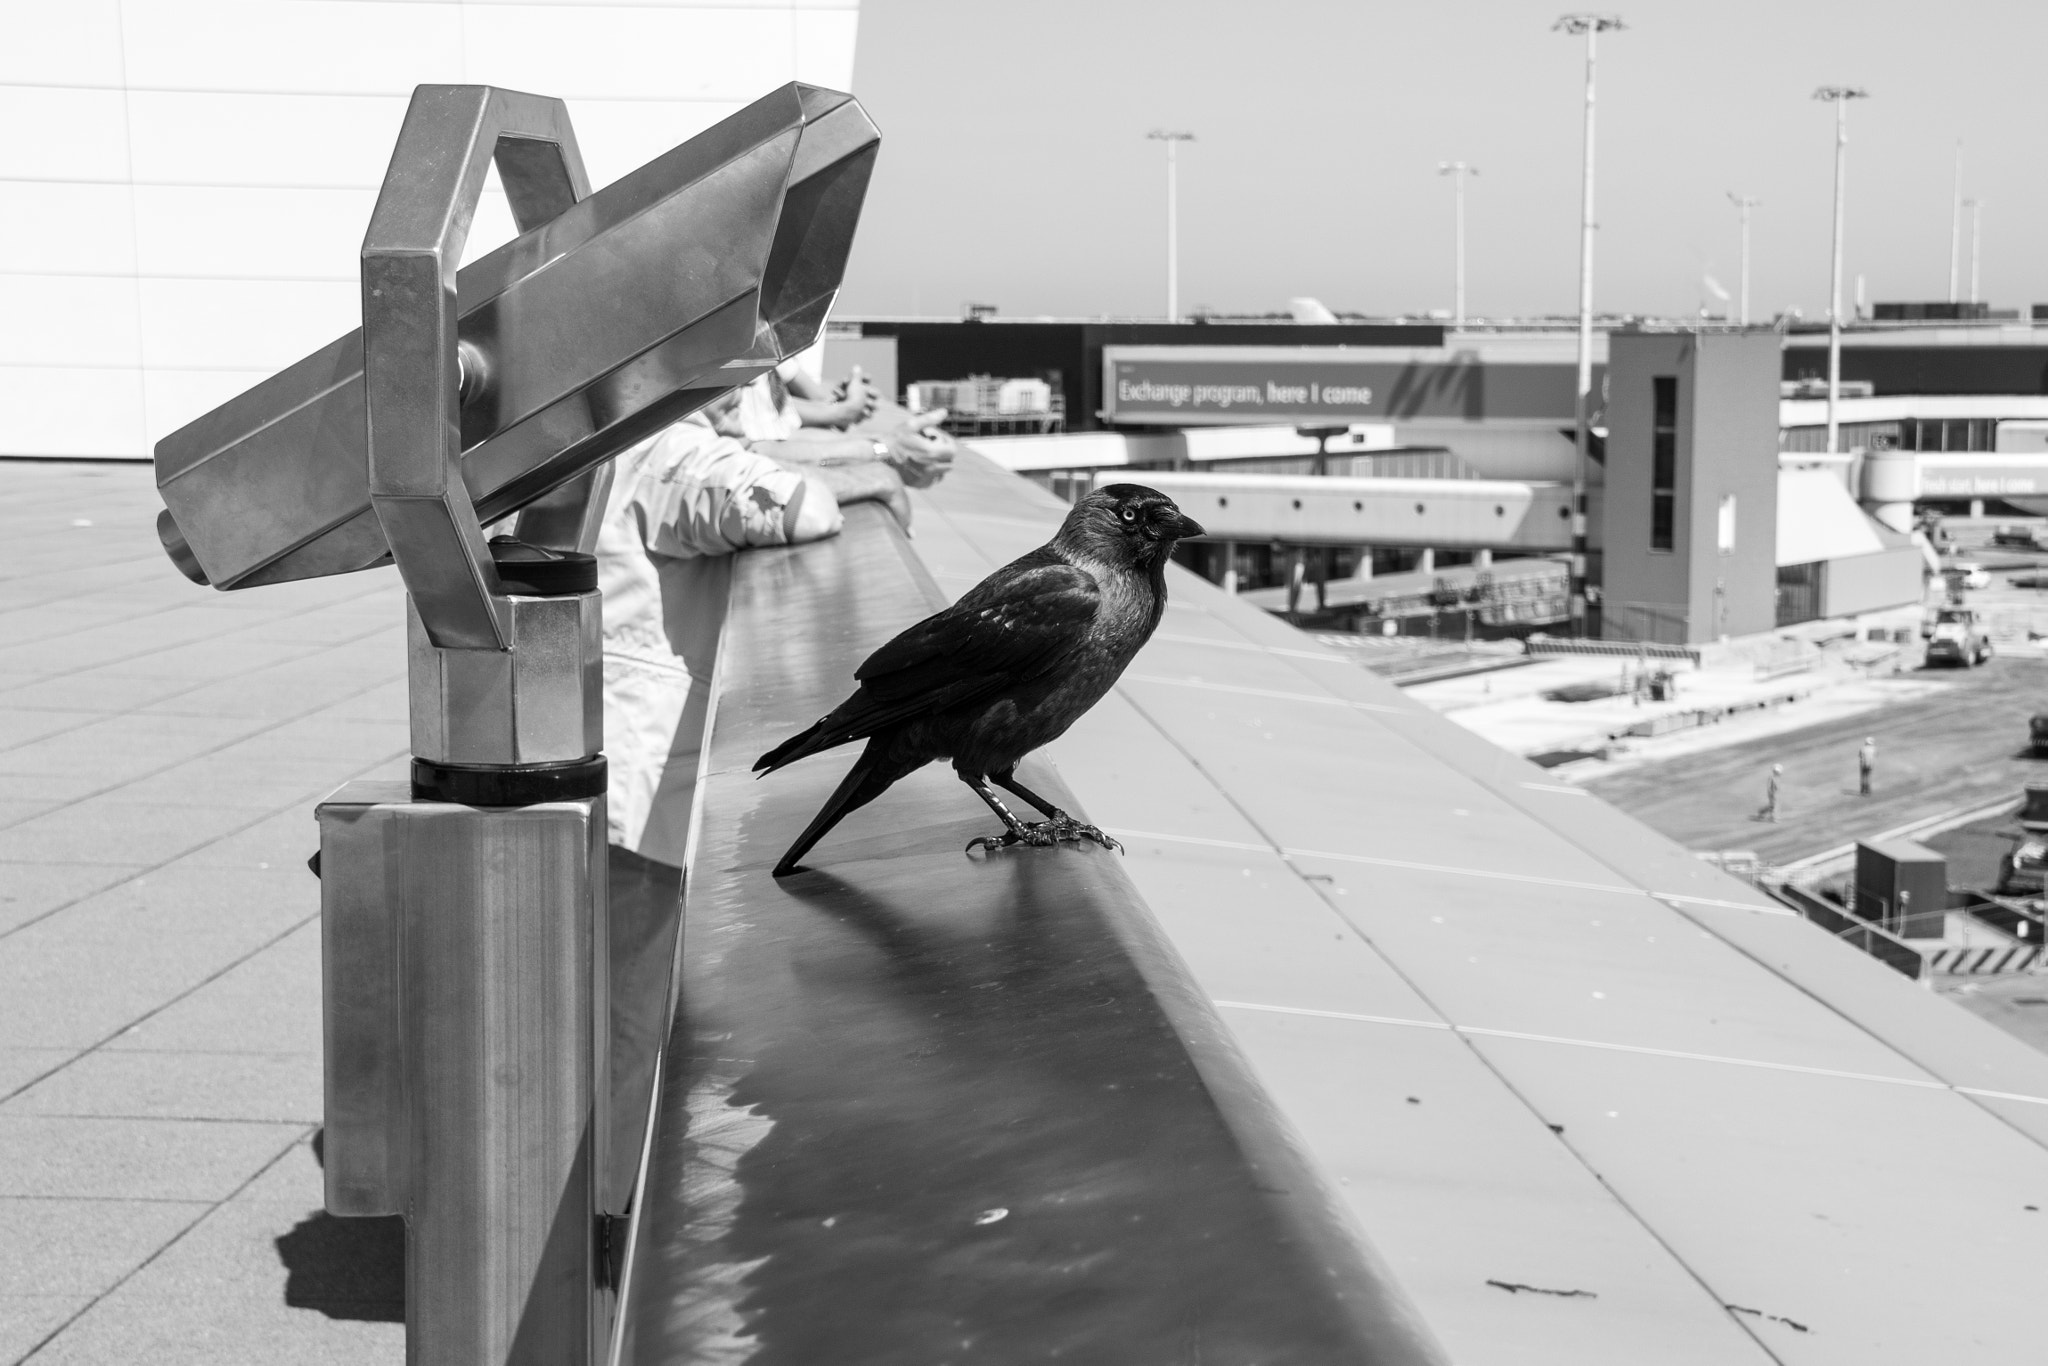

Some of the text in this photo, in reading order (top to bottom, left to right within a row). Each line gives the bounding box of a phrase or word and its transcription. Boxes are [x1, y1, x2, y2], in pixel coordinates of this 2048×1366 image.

[1119, 379, 1372, 407] Exchange program, here I come
